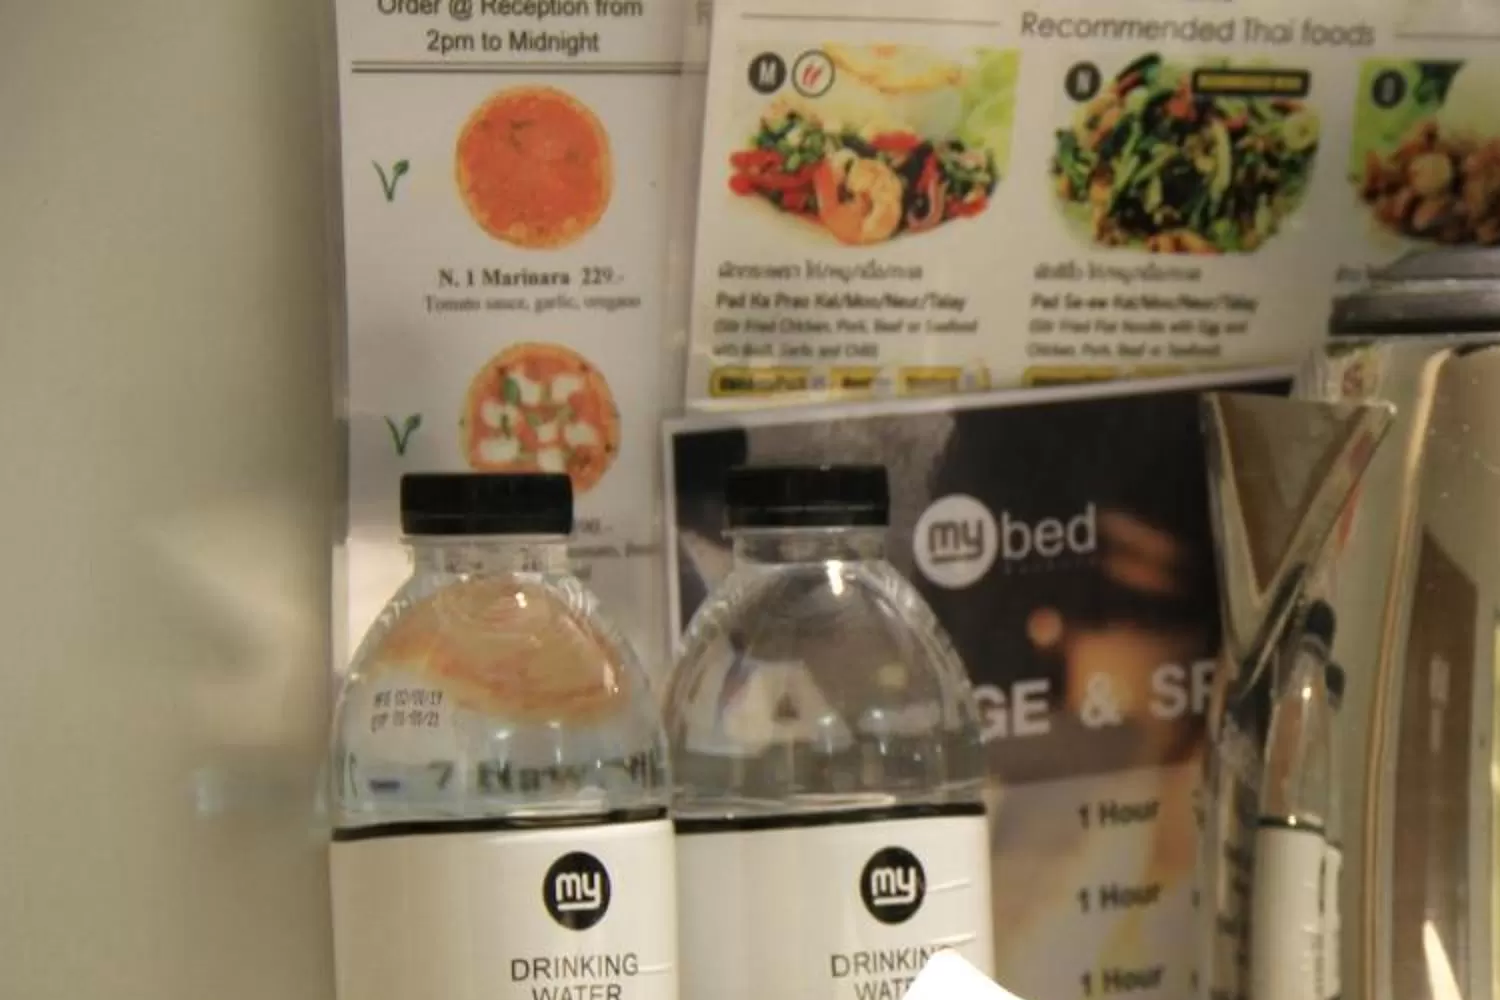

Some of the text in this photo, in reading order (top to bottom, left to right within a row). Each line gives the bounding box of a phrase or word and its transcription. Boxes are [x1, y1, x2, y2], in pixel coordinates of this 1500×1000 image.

[377, 0, 643, 20] Order @ Reception from
[427, 29, 600, 56] 2pm to Midnight
[1020, 10, 1375, 46] Recommended Thai foods
[438, 268, 460, 288] N.
[466, 268, 475, 287] 1
[482, 267, 571, 287] Marinara
[927, 501, 1098, 565] my bed
[1080, 671, 1123, 728] &
[1078, 803, 1090, 829] 1
[1099, 800, 1160, 825] Hour
[555, 872, 601, 912] my
[870, 866, 917, 907] my
[1078, 887, 1090, 914] 1
[1099, 884, 1162, 910] Hour
[511, 952, 639, 982] DRINKING
[1081, 970, 1093, 997] 1
[1101, 967, 1165, 994] Hour
